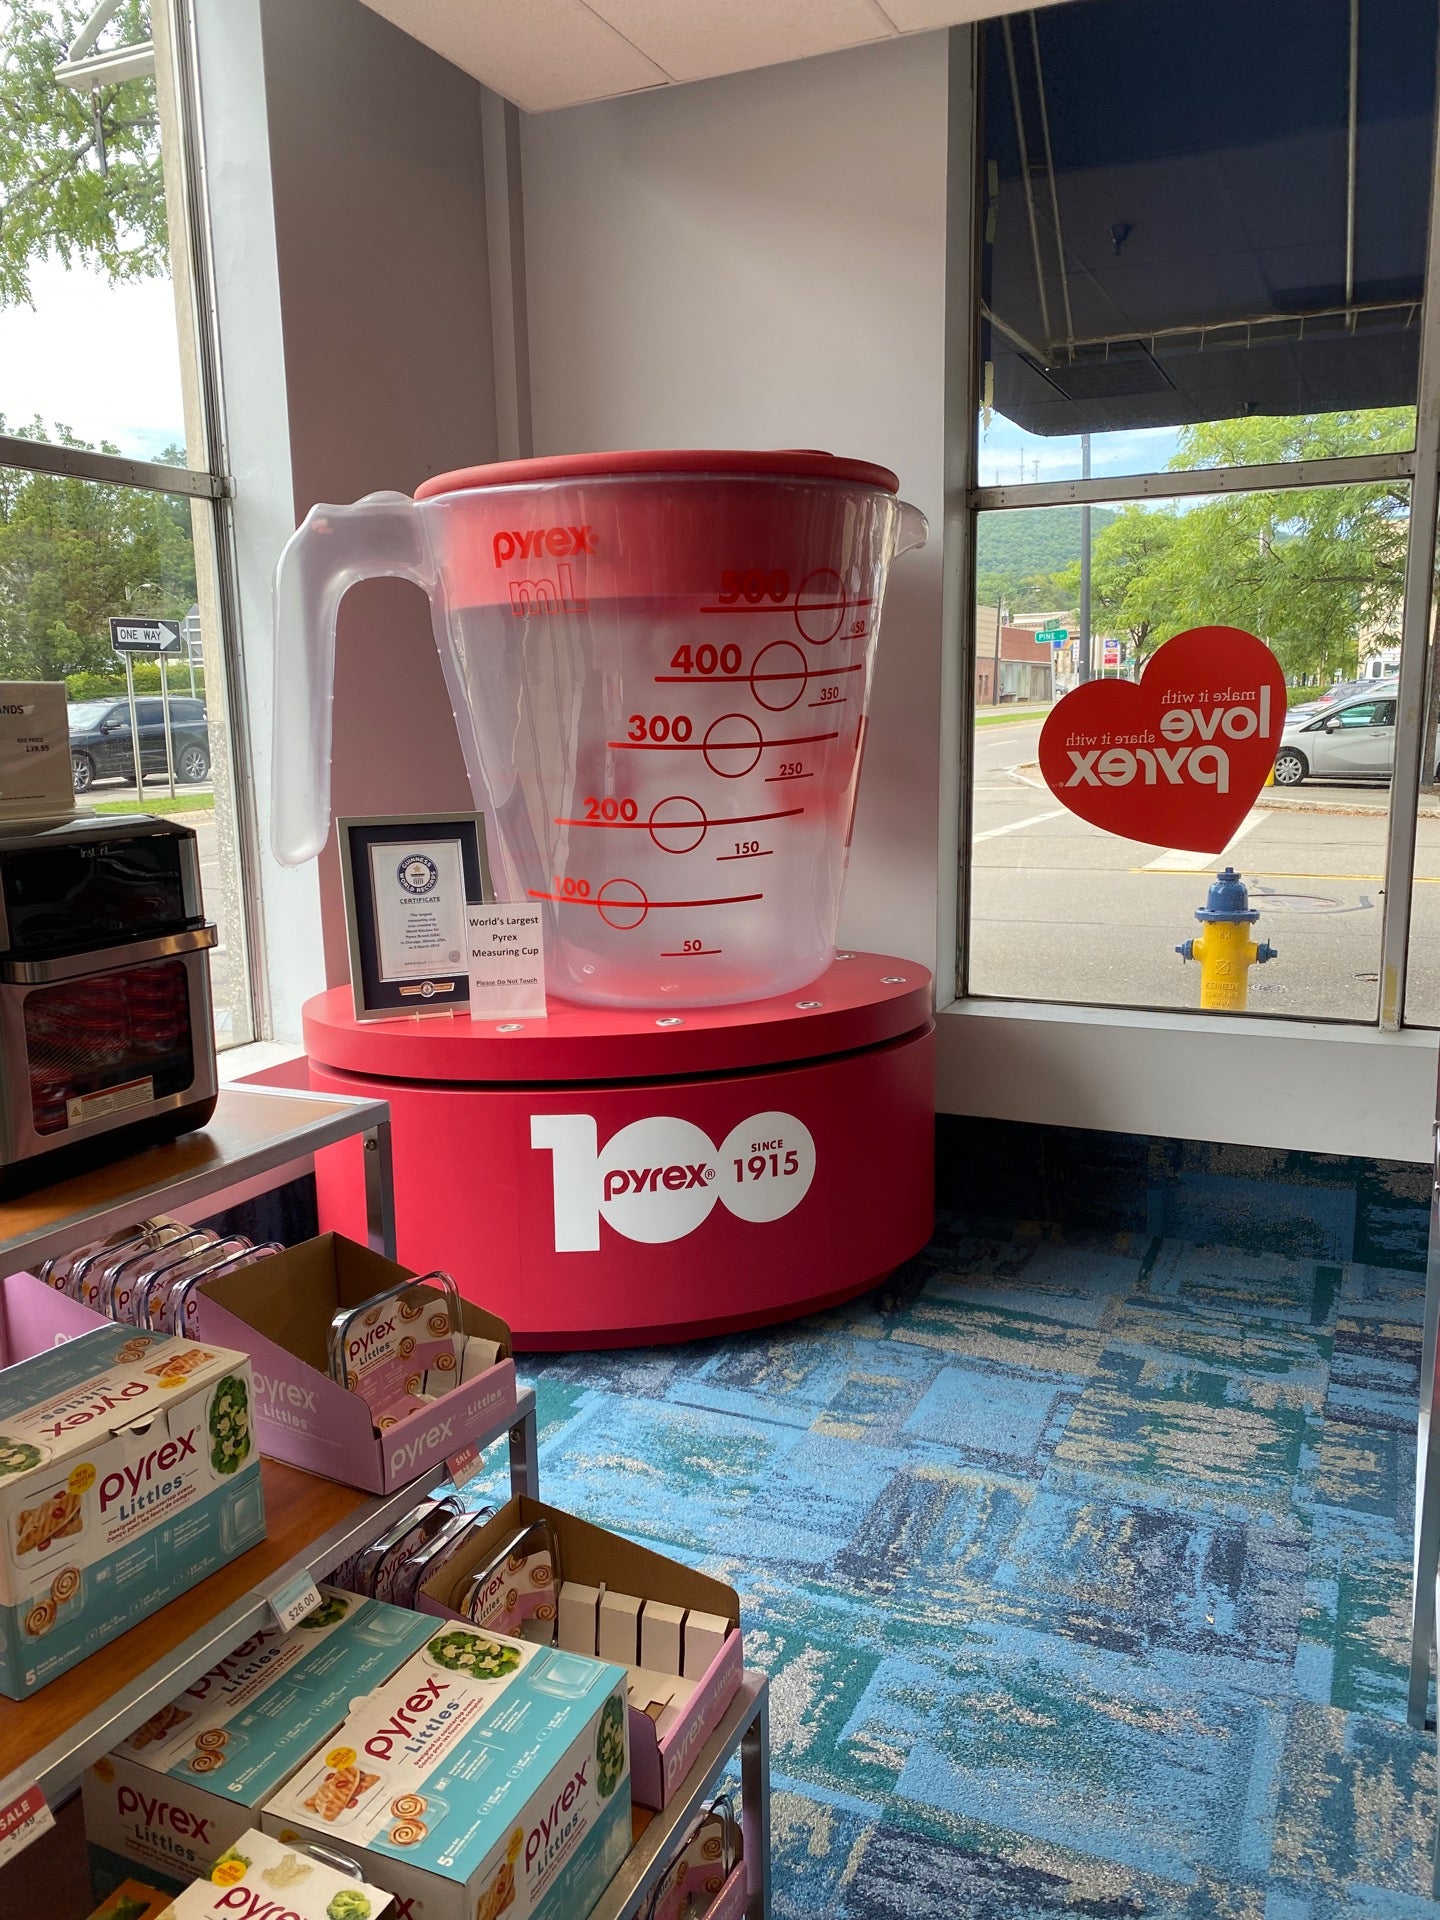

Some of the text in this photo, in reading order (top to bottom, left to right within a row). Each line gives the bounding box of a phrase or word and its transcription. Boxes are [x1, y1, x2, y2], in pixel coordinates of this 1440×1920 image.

[509, 563, 589, 616] mL
[718, 568, 790, 604] 500
[120, 629, 161, 640] ONE WAY
[1038, 632, 1056, 641] PINE
[670, 643, 742, 674] 400
[821, 687, 839, 701] 350
[627, 714, 693, 742] 300
[779, 762, 803, 777] 250
[583, 796, 638, 821] 200
[735, 841, 759, 855] 150
[401, 856, 432, 869] GUINNESS
[400, 871, 436, 893] WORLD RECORDS
[553, 876, 591, 897] 100
[399, 896, 441, 905] CERTIFICATE
[469, 916, 539, 927] World's Largest
[492, 933, 518, 943] Pyrex
[683, 939, 702, 952] 50
[472, 947, 539, 958] Measuring Cup
[750, 1139, 784, 1153] SINCE
[733, 1150, 799, 1183] 1915
[359, 1341, 391, 1366] Littles
[467, 1388, 502, 1416] Littles
[264, 1403, 308, 1430] Littles
[455, 1449, 471, 1466] SALE
[119, 1475, 183, 1521] Littles
[288, 1593, 315, 1621] $26.00
[25, 1668, 36, 1686] 5
[221, 1648, 281, 1693] Littles
[404, 1702, 460, 1753] Littles
[227, 1782, 244, 1793] 5
[0, 1800, 31, 1831] SALE
[134, 1823, 195, 1862] Littles
[537, 1812, 579, 1877] Littles
[437, 1856, 454, 1867] 5
